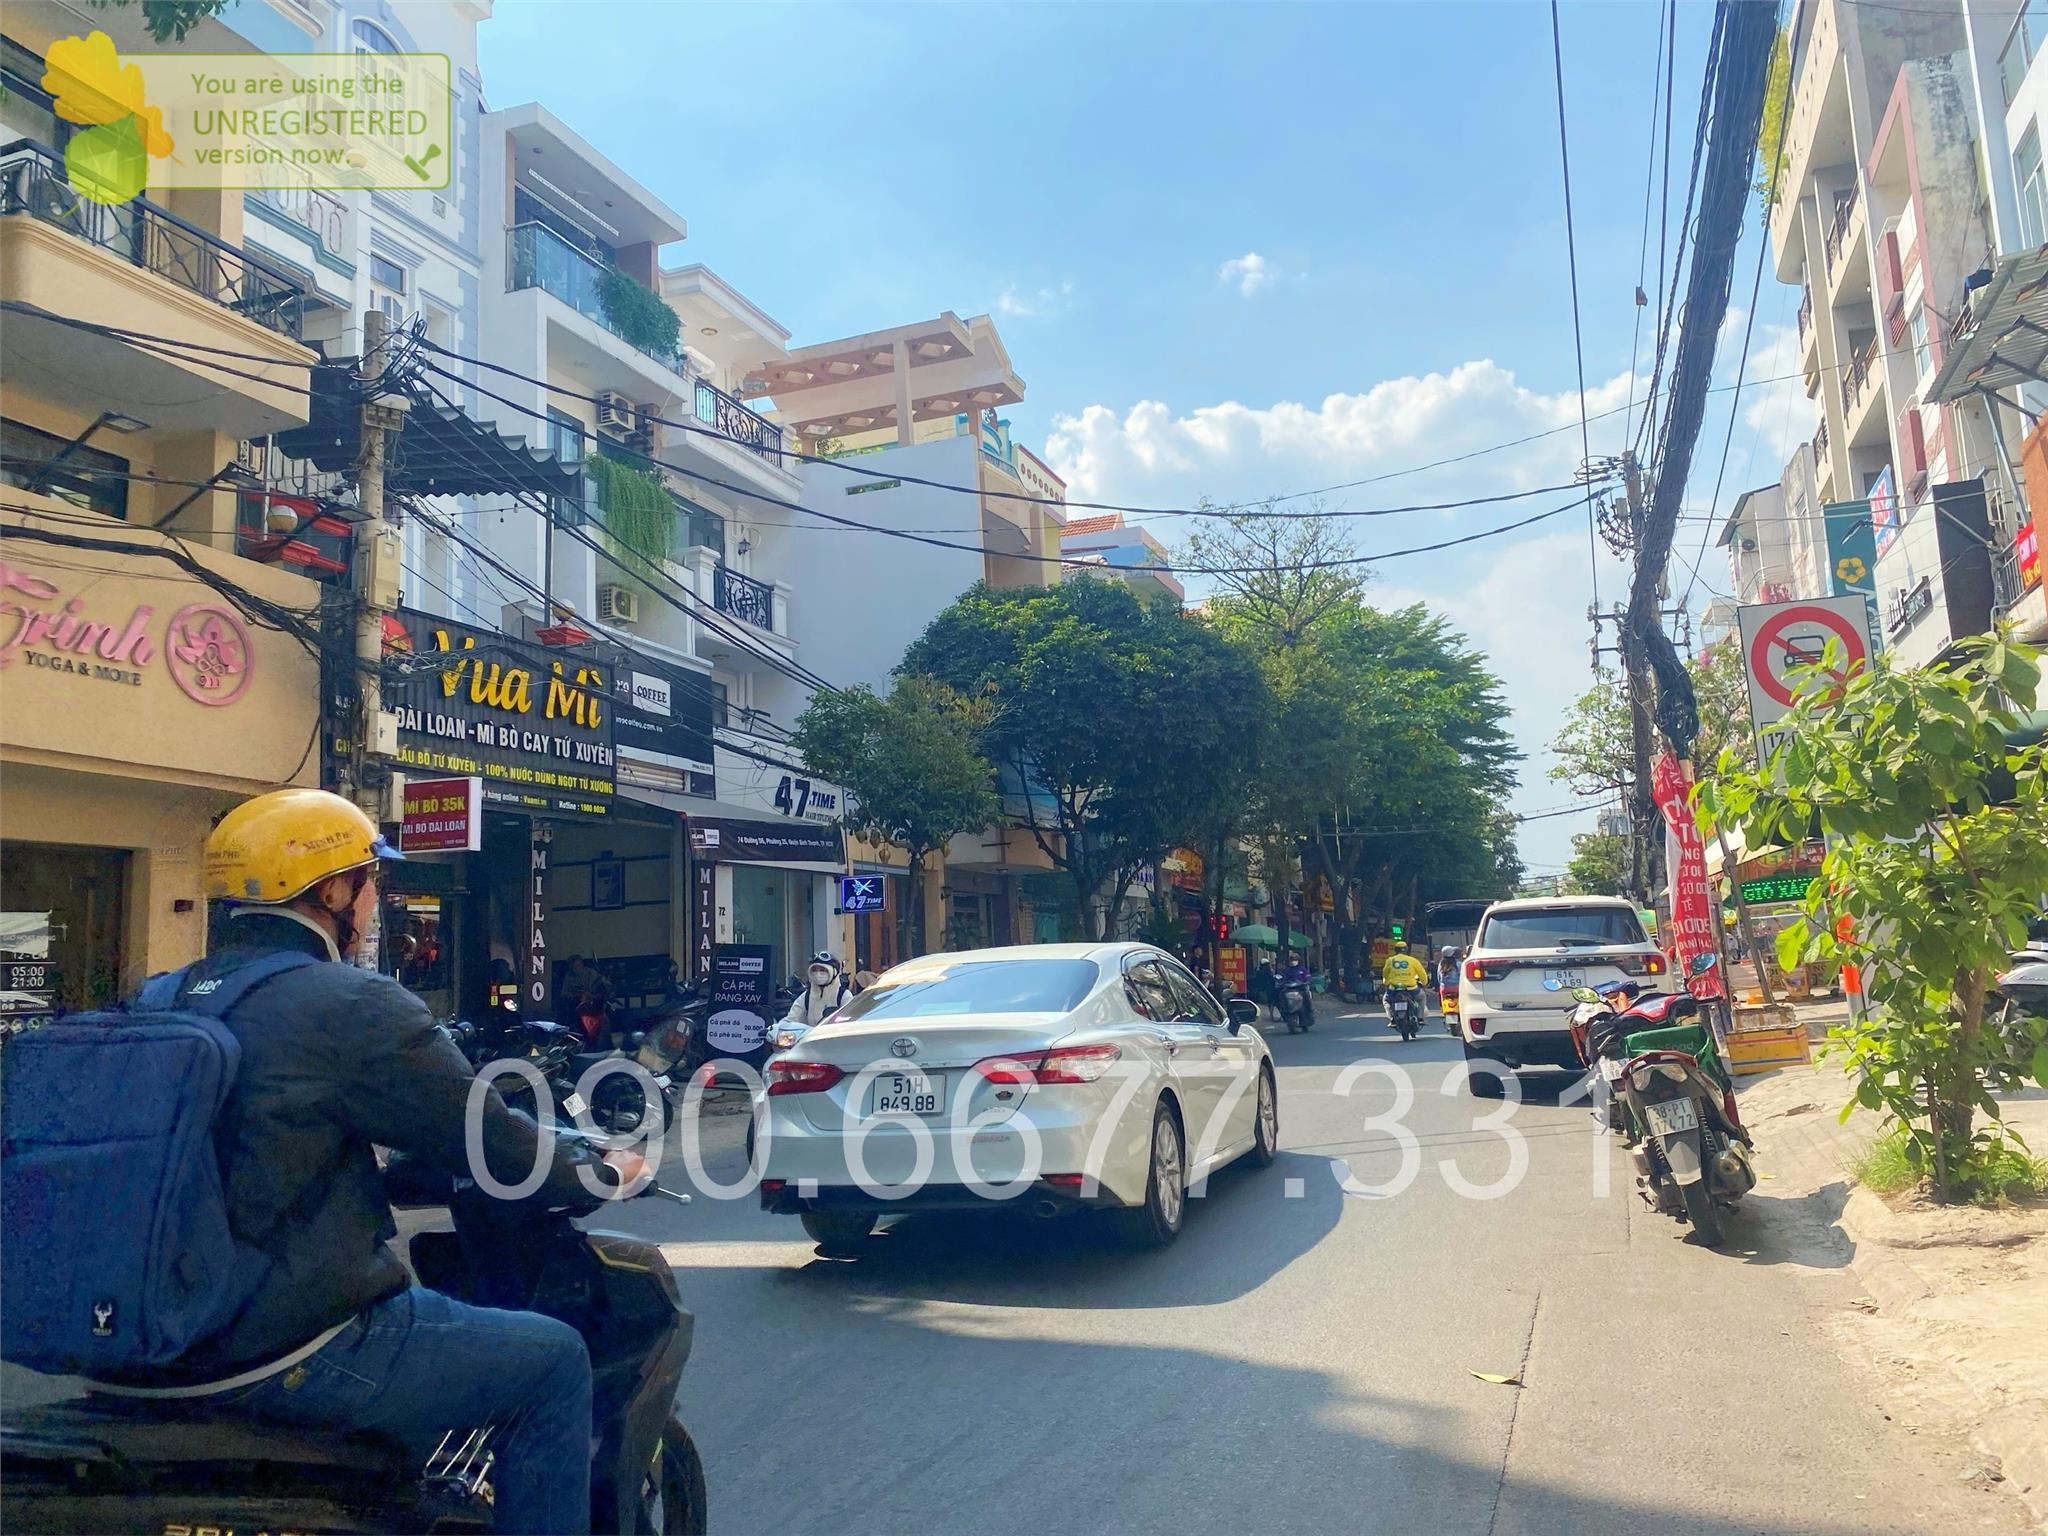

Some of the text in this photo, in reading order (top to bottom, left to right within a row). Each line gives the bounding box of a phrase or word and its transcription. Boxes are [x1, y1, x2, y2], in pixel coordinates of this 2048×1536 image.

[26, 650, 143, 687] YOGA & MORE
[435, 630, 603, 729] Vua Mì
[636, 685, 667, 703] COFFEE
[426, 711, 466, 741] LOAN
[477, 719, 495, 747] MÌ
[499, 722, 519, 750] BÒ
[523, 731, 549, 755] CAY
[554, 734, 572, 759] TỨ
[575, 741, 613, 768] XUYÊN
[447, 756, 476, 773] XUYÊN
[485, 763, 509, 778] 100%
[442, 796, 465, 812] 35K
[718, 906, 726, 916] 72
[531, 850, 547, 1001] MILANO
[11, 966, 45, 977] 05:00
[1556, 970, 1574, 979] 61K
[11, 976, 45, 988] 21:00
[738, 980, 756, 991] PHÊ
[714, 992, 762, 1003] RANG XAY
[893, 1077, 924, 1094] 51H
[880, 1095, 935, 1112] 849.88
[1652, 1101, 1686, 1119] 38-P1
